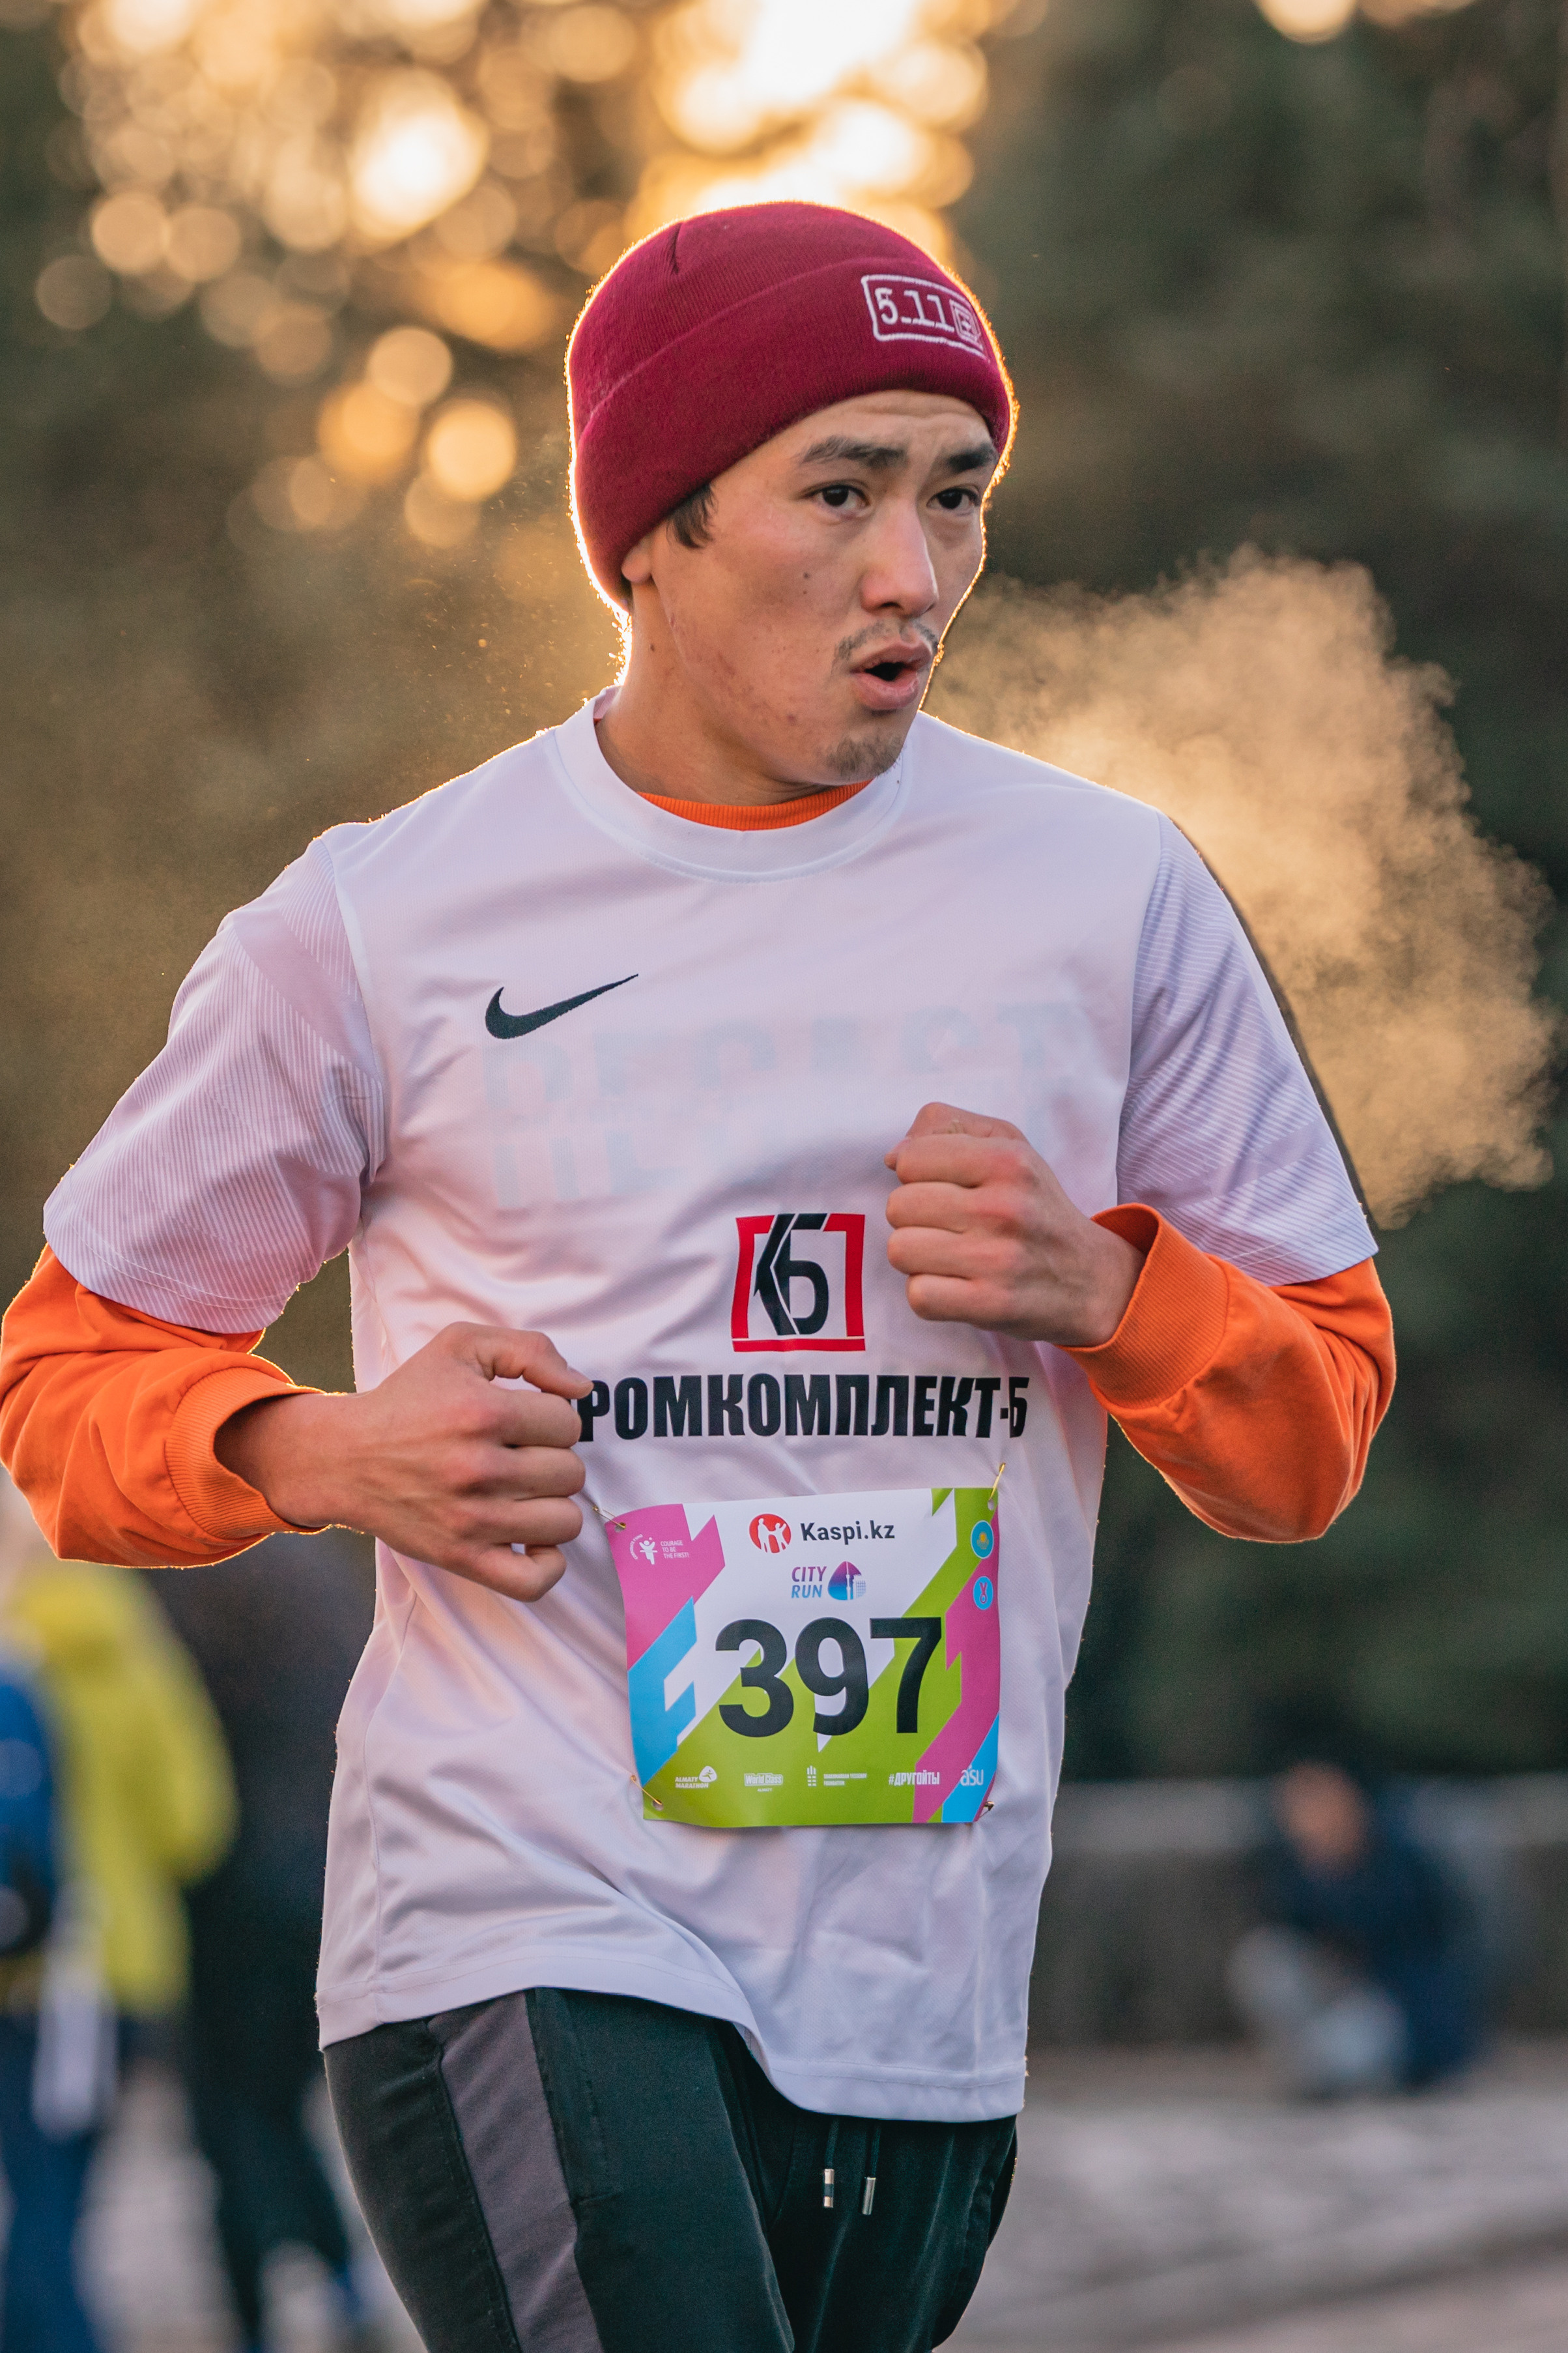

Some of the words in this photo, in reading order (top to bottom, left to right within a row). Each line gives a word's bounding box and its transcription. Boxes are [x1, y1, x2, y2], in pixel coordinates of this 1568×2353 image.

[569, 1373, 1030, 1443] РОМКОМПЛЕКТ-Б
[800, 1520, 895, 1545] Kaspi.kz
[791, 1566, 827, 1582] CITY
[791, 1584, 823, 1598] RUN
[715, 1617, 942, 1738] 397
[745, 1774, 764, 1784] World
[765, 1774, 782, 1784] Class
[889, 1769, 940, 1786] #ДРУГОЙТЫ
